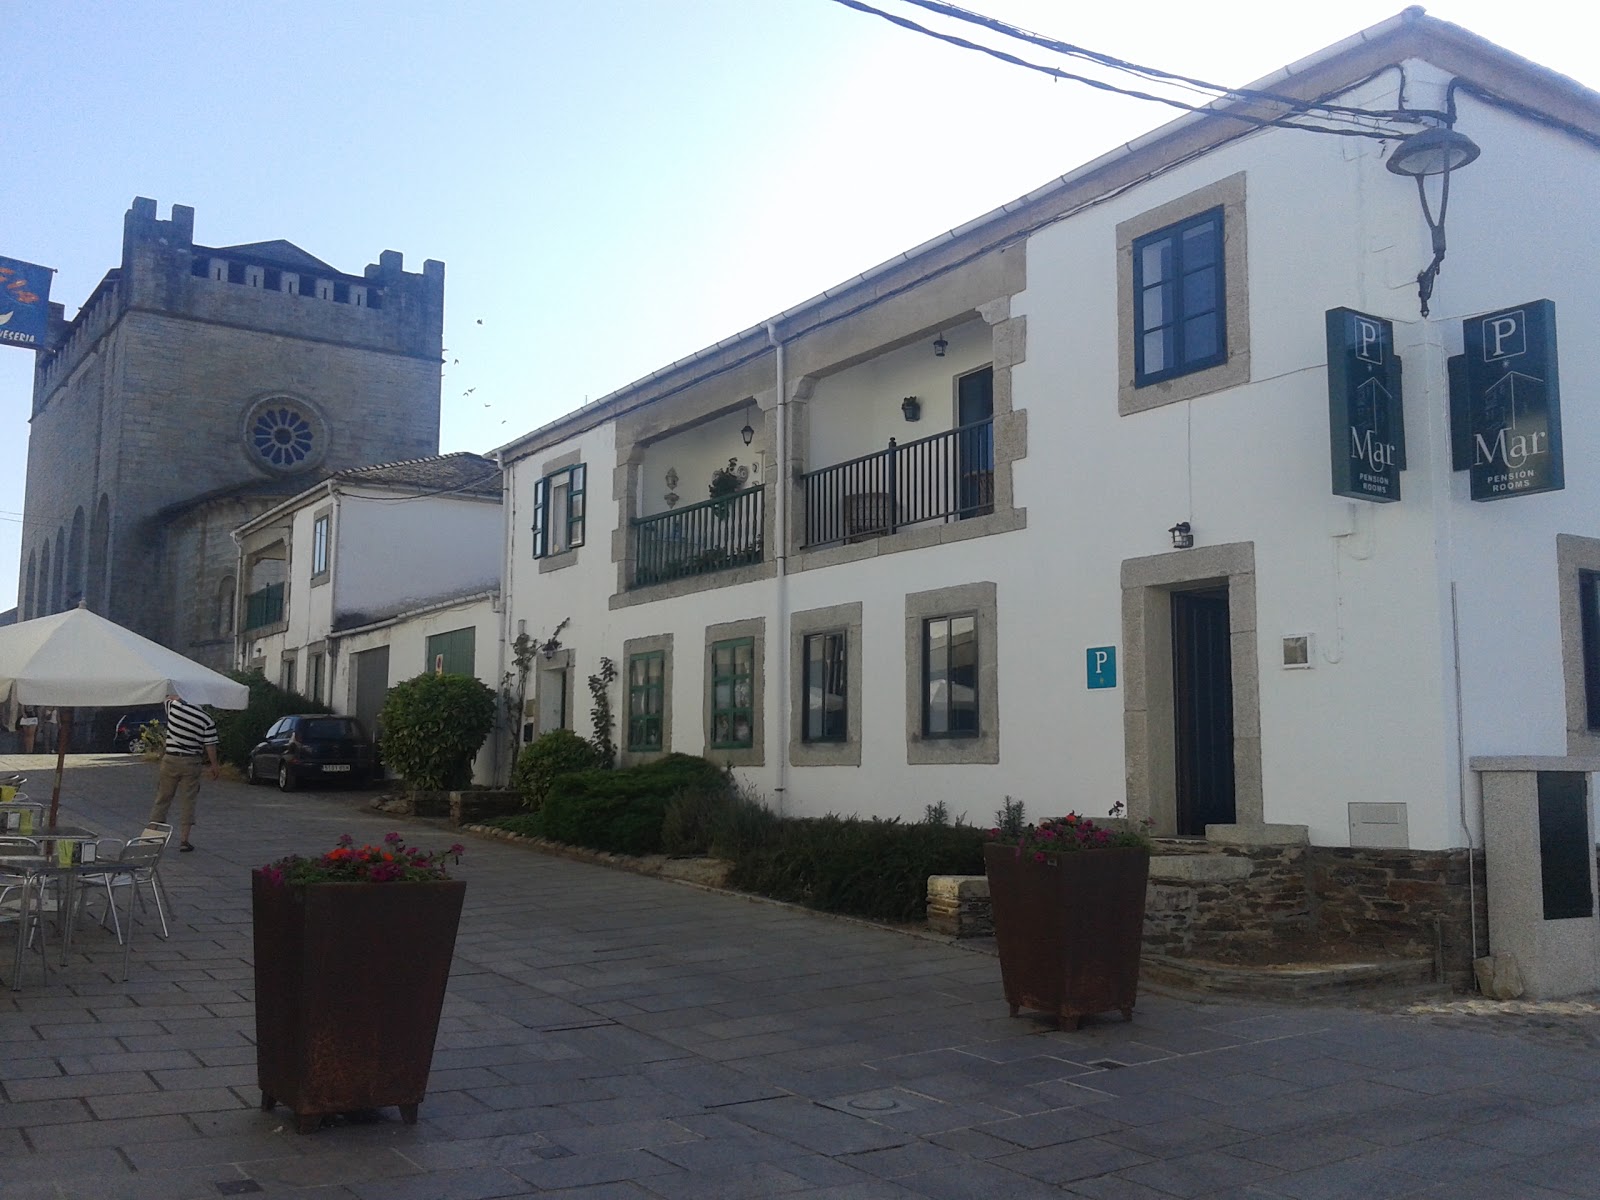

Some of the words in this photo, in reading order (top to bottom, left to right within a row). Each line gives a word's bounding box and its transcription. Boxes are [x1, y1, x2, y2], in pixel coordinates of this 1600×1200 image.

[1359, 321, 1376, 357] P
[1491, 318, 1516, 356] P
[1350, 426, 1396, 473] Mar
[1474, 427, 1546, 469] Mar
[1359, 472, 1389, 485] PENSION
[1362, 482, 1387, 494] ROOMS
[1487, 469, 1535, 484] PENSION
[1492, 479, 1530, 492] ROOMS
[1094, 651, 1108, 674] P
